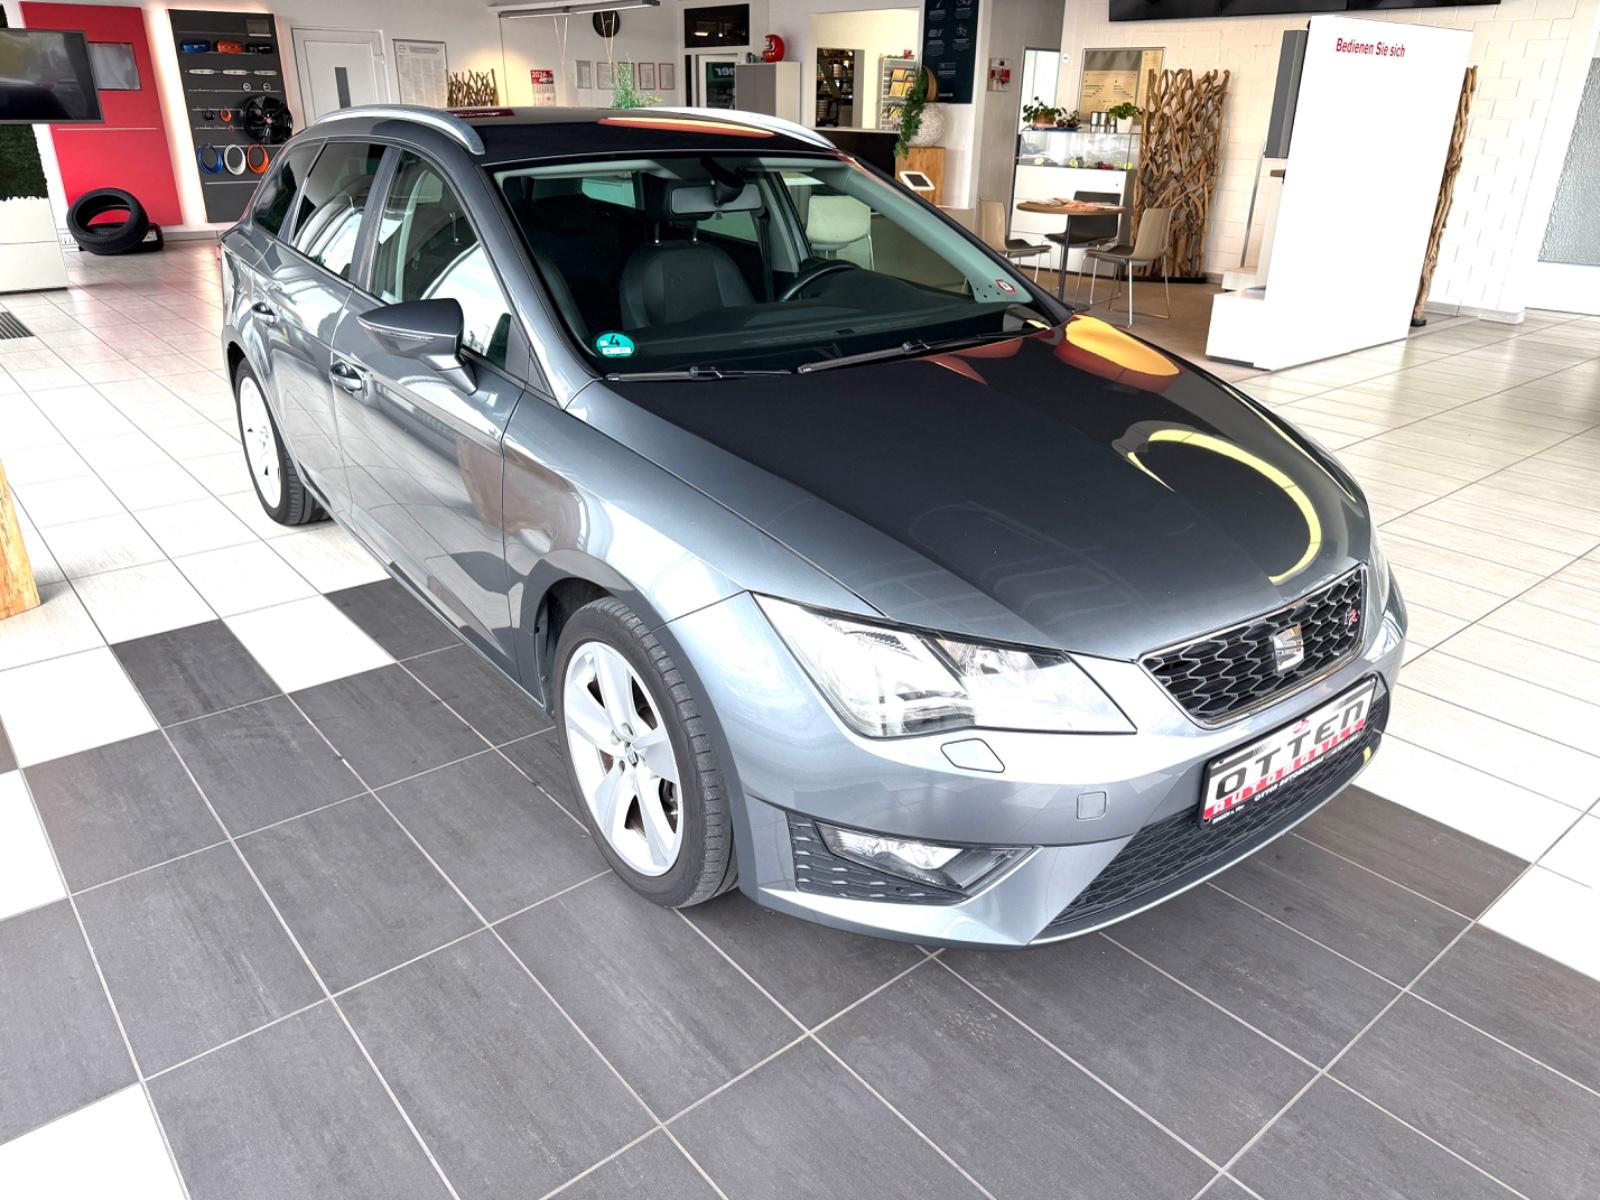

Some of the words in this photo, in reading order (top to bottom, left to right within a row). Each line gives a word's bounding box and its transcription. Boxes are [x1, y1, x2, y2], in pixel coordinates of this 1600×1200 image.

[1336, 37, 1374, 55] Bedienen
[1375, 41, 1388, 56] Sie
[1389, 43, 1405, 57] sich
[610, 335, 620, 347] 4
[1213, 720, 1357, 813] AUTOMOBILE
[1216, 700, 1364, 800] OTTEN
